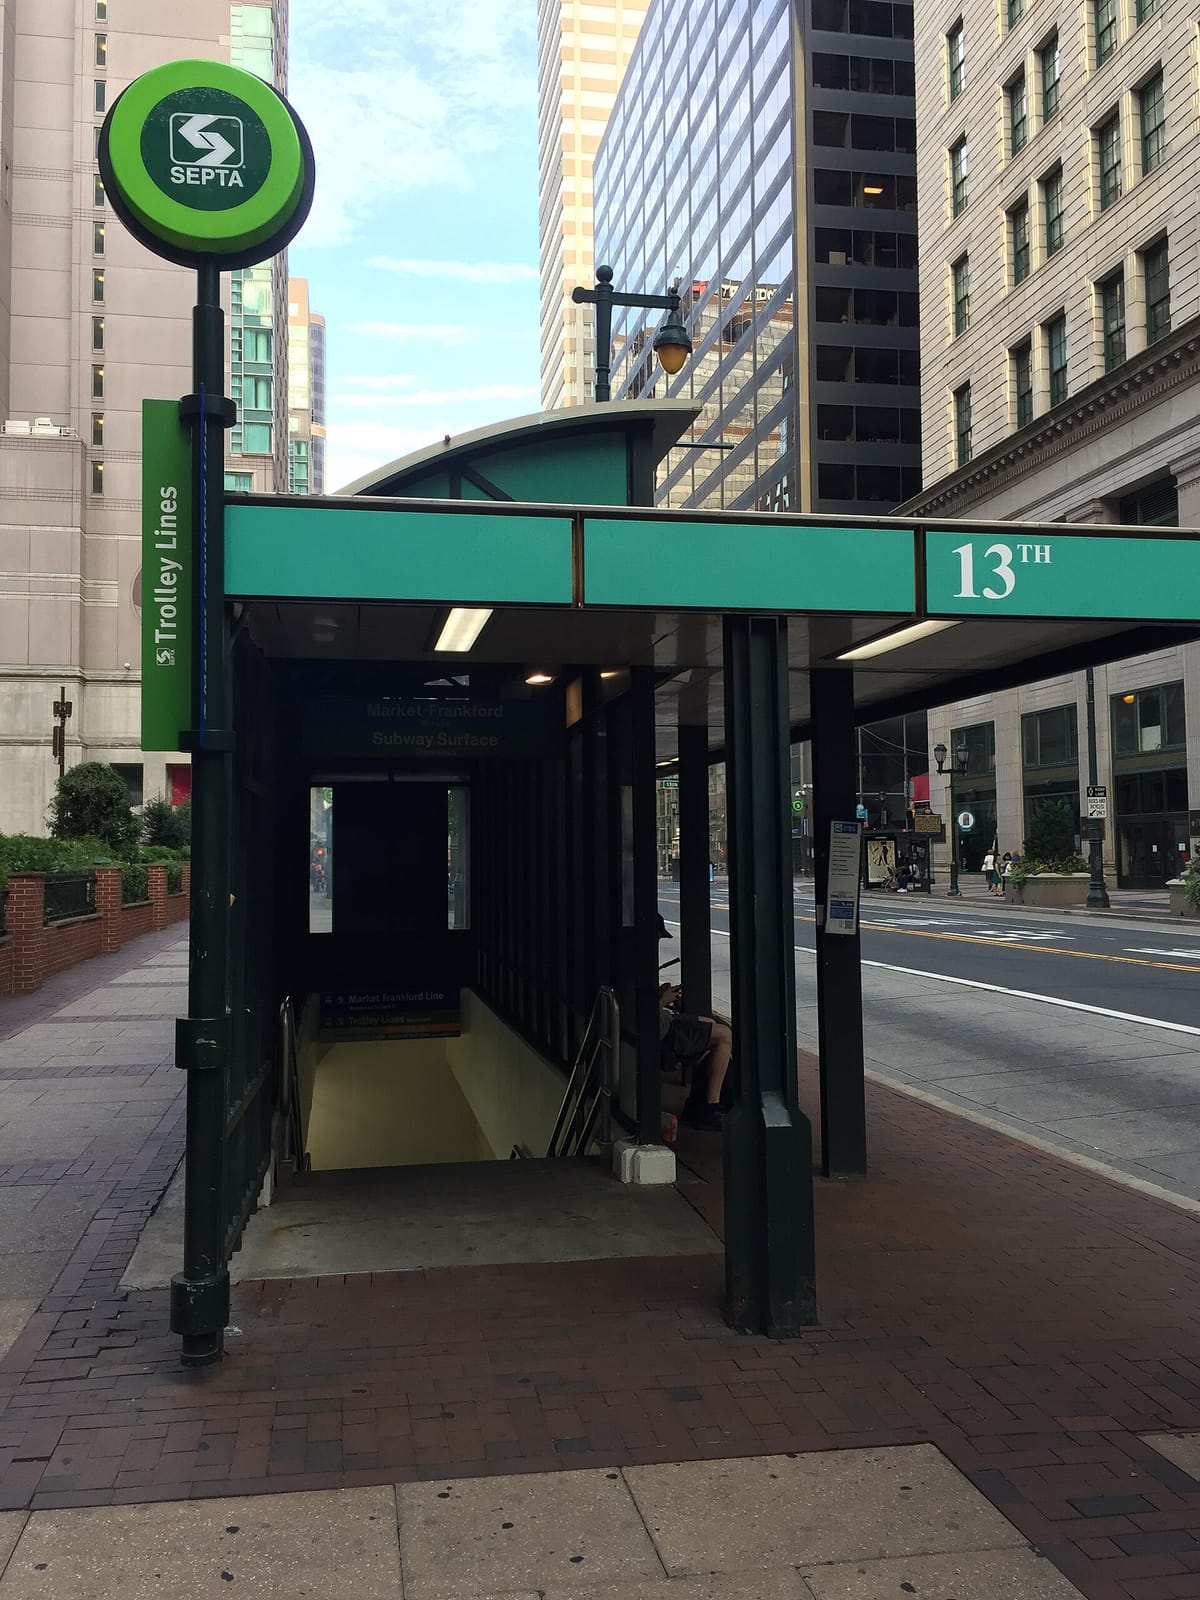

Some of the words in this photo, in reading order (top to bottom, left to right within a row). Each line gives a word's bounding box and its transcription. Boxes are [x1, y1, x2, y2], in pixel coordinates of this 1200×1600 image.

[171, 166, 244, 188] SEPTA
[153, 486, 178, 549] Lines
[153, 557, 183, 644] Trolley
[371, 730, 435, 748] Subway
[436, 730, 498, 746] Surface
